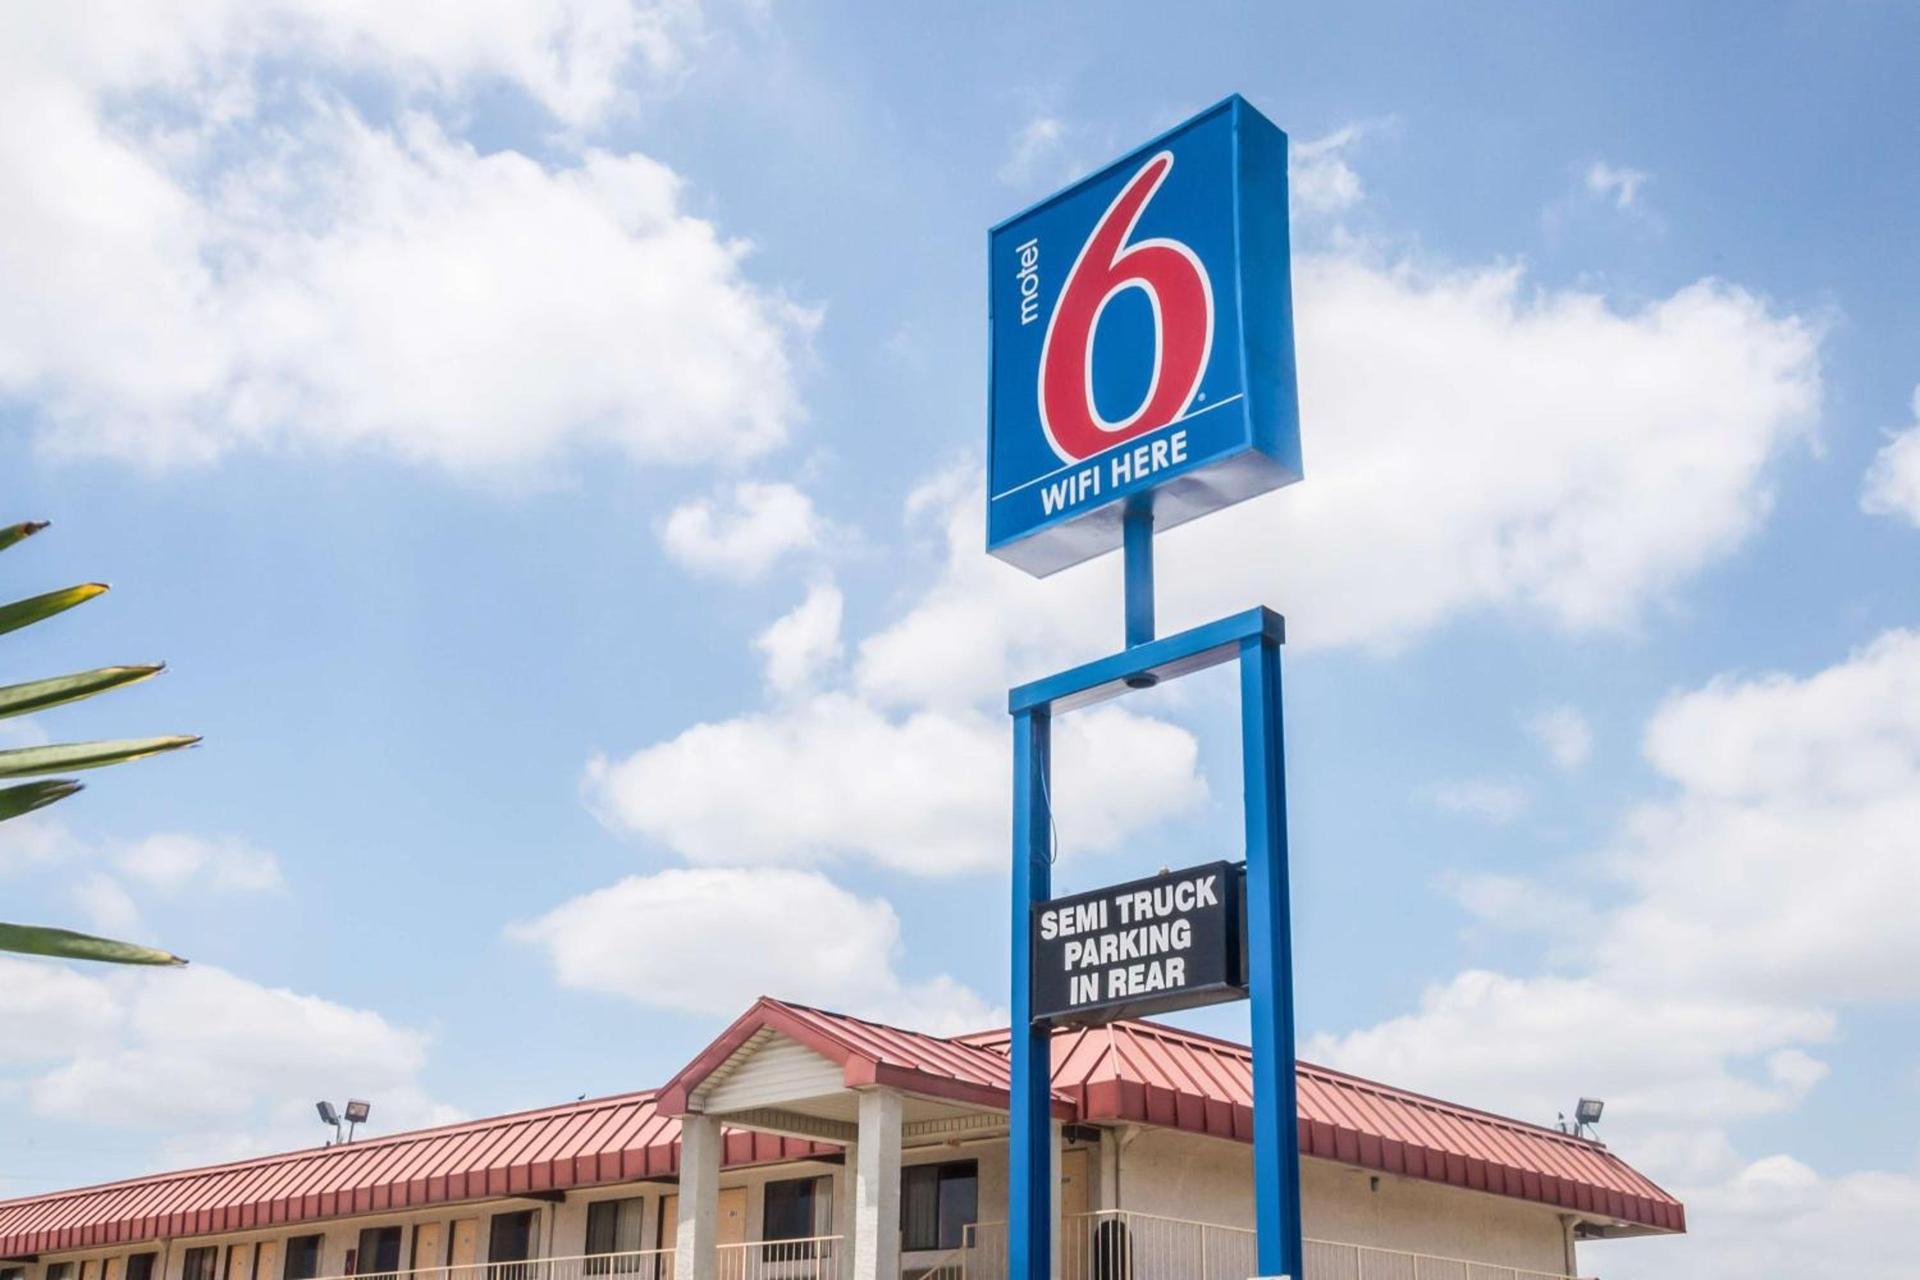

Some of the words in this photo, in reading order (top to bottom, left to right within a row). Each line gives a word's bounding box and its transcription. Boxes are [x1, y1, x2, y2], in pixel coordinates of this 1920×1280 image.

[1015, 238, 1039, 325] motel
[1037, 150, 1215, 465] 6
[1041, 465, 1100, 516] WIFI
[1111, 430, 1188, 488] HERE
[1041, 900, 1108, 940] SEMI
[1115, 875, 1218, 924] TRUCK
[1064, 919, 1192, 971] PARKING
[1069, 972, 1099, 1005] IN
[1108, 957, 1186, 998] REAR
